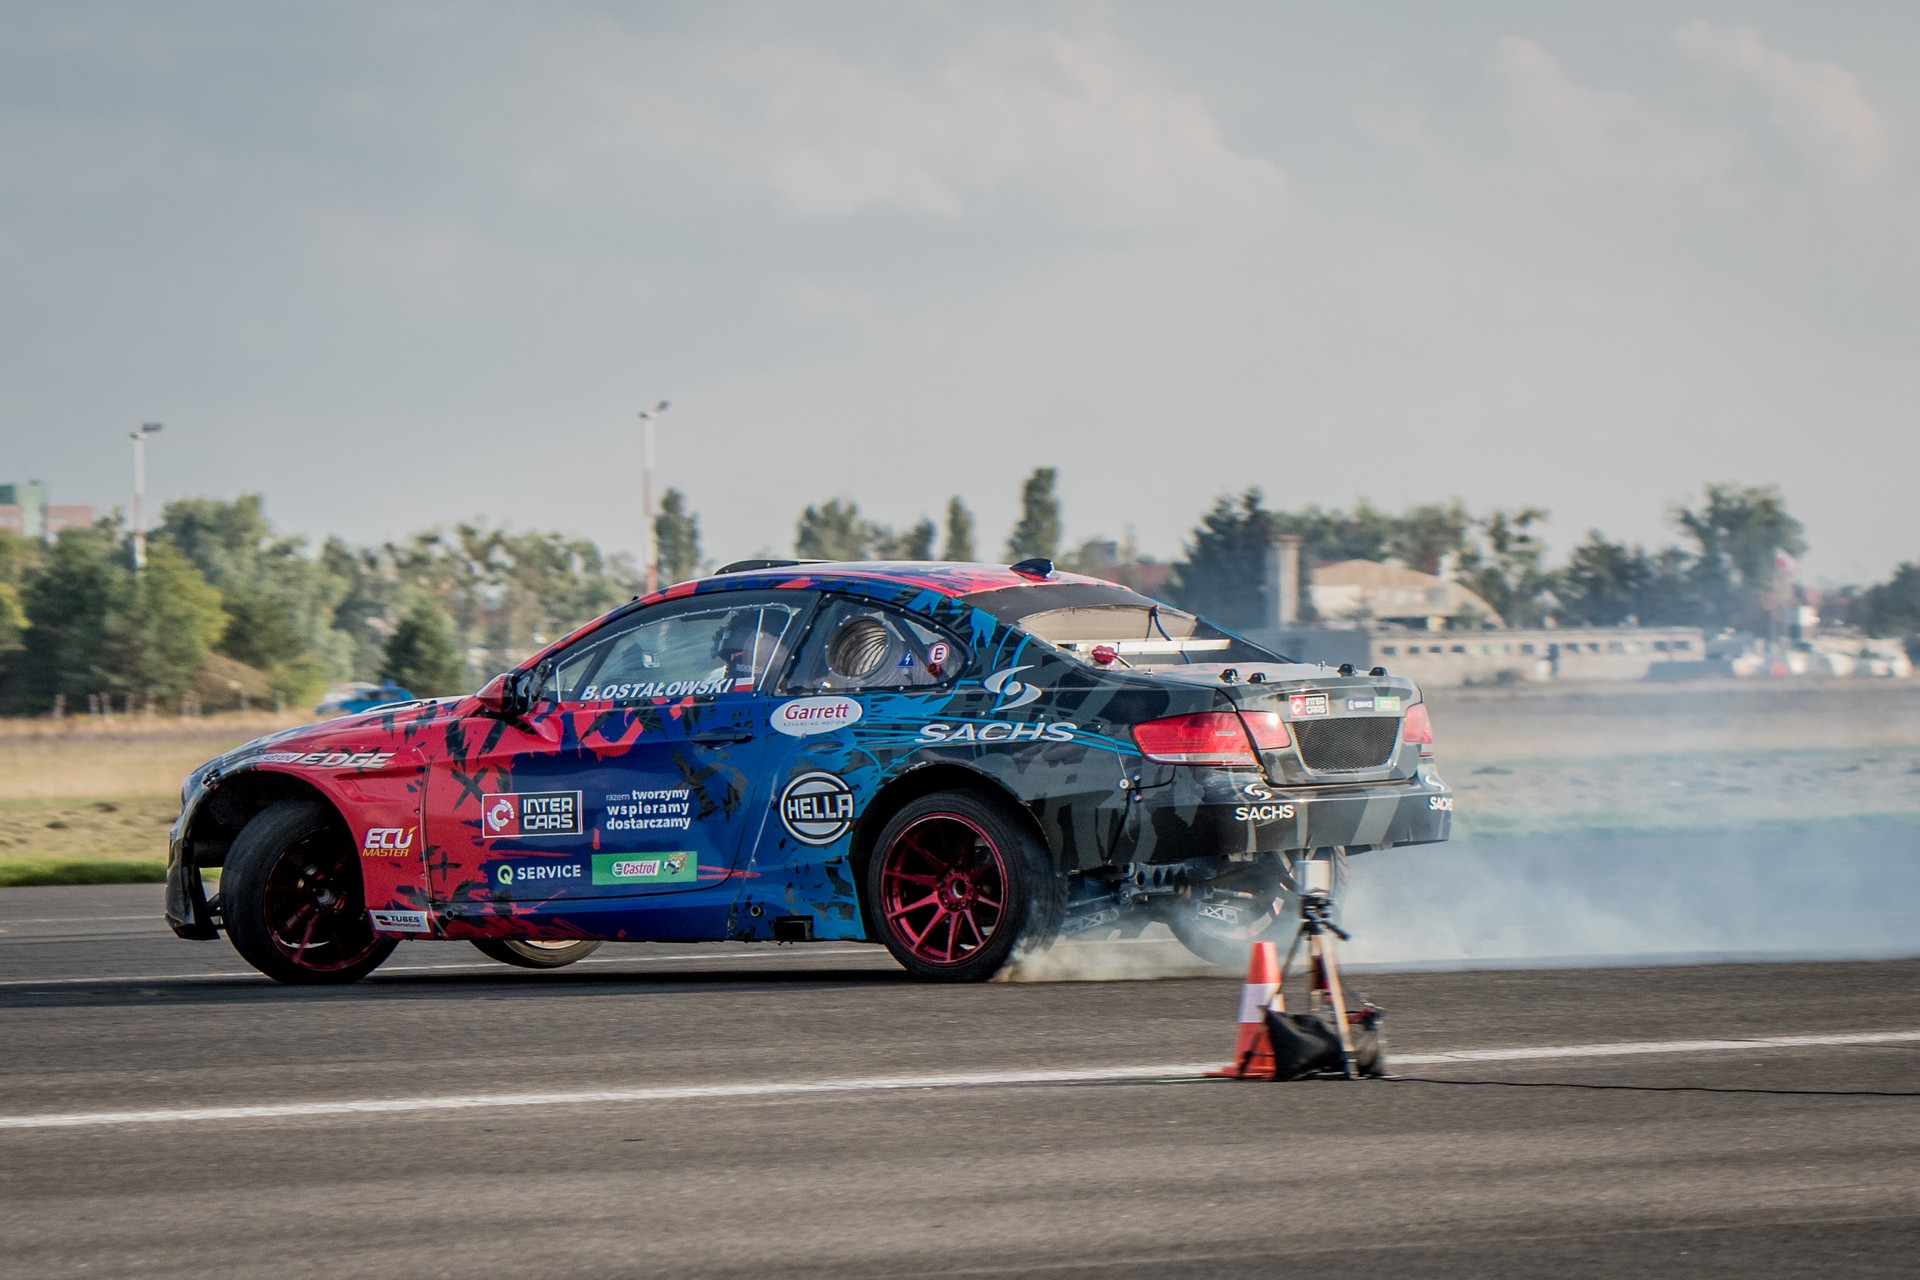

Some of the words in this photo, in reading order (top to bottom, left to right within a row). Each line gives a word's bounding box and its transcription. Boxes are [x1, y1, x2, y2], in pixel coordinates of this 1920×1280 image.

[785, 704, 849, 720] Garrett
[914, 722, 1077, 743] SACHS
[297, 753, 396, 769] EDGE
[606, 793, 630, 801] razem
[632, 789, 690, 801] tworzymy
[523, 797, 574, 813] INTER
[606, 801, 690, 818] wspieramy
[787, 794, 854, 820] HELLA
[1234, 805, 1295, 821] SACHS
[523, 813, 574, 830] CARS
[606, 816, 691, 831] dostarczamy
[364, 826, 417, 849] ECU
[362, 848, 410, 858] MASTER
[517, 864, 581, 880] SERVICE
[623, 862, 657, 877] Castrol
[390, 915, 420, 923] TUBES
